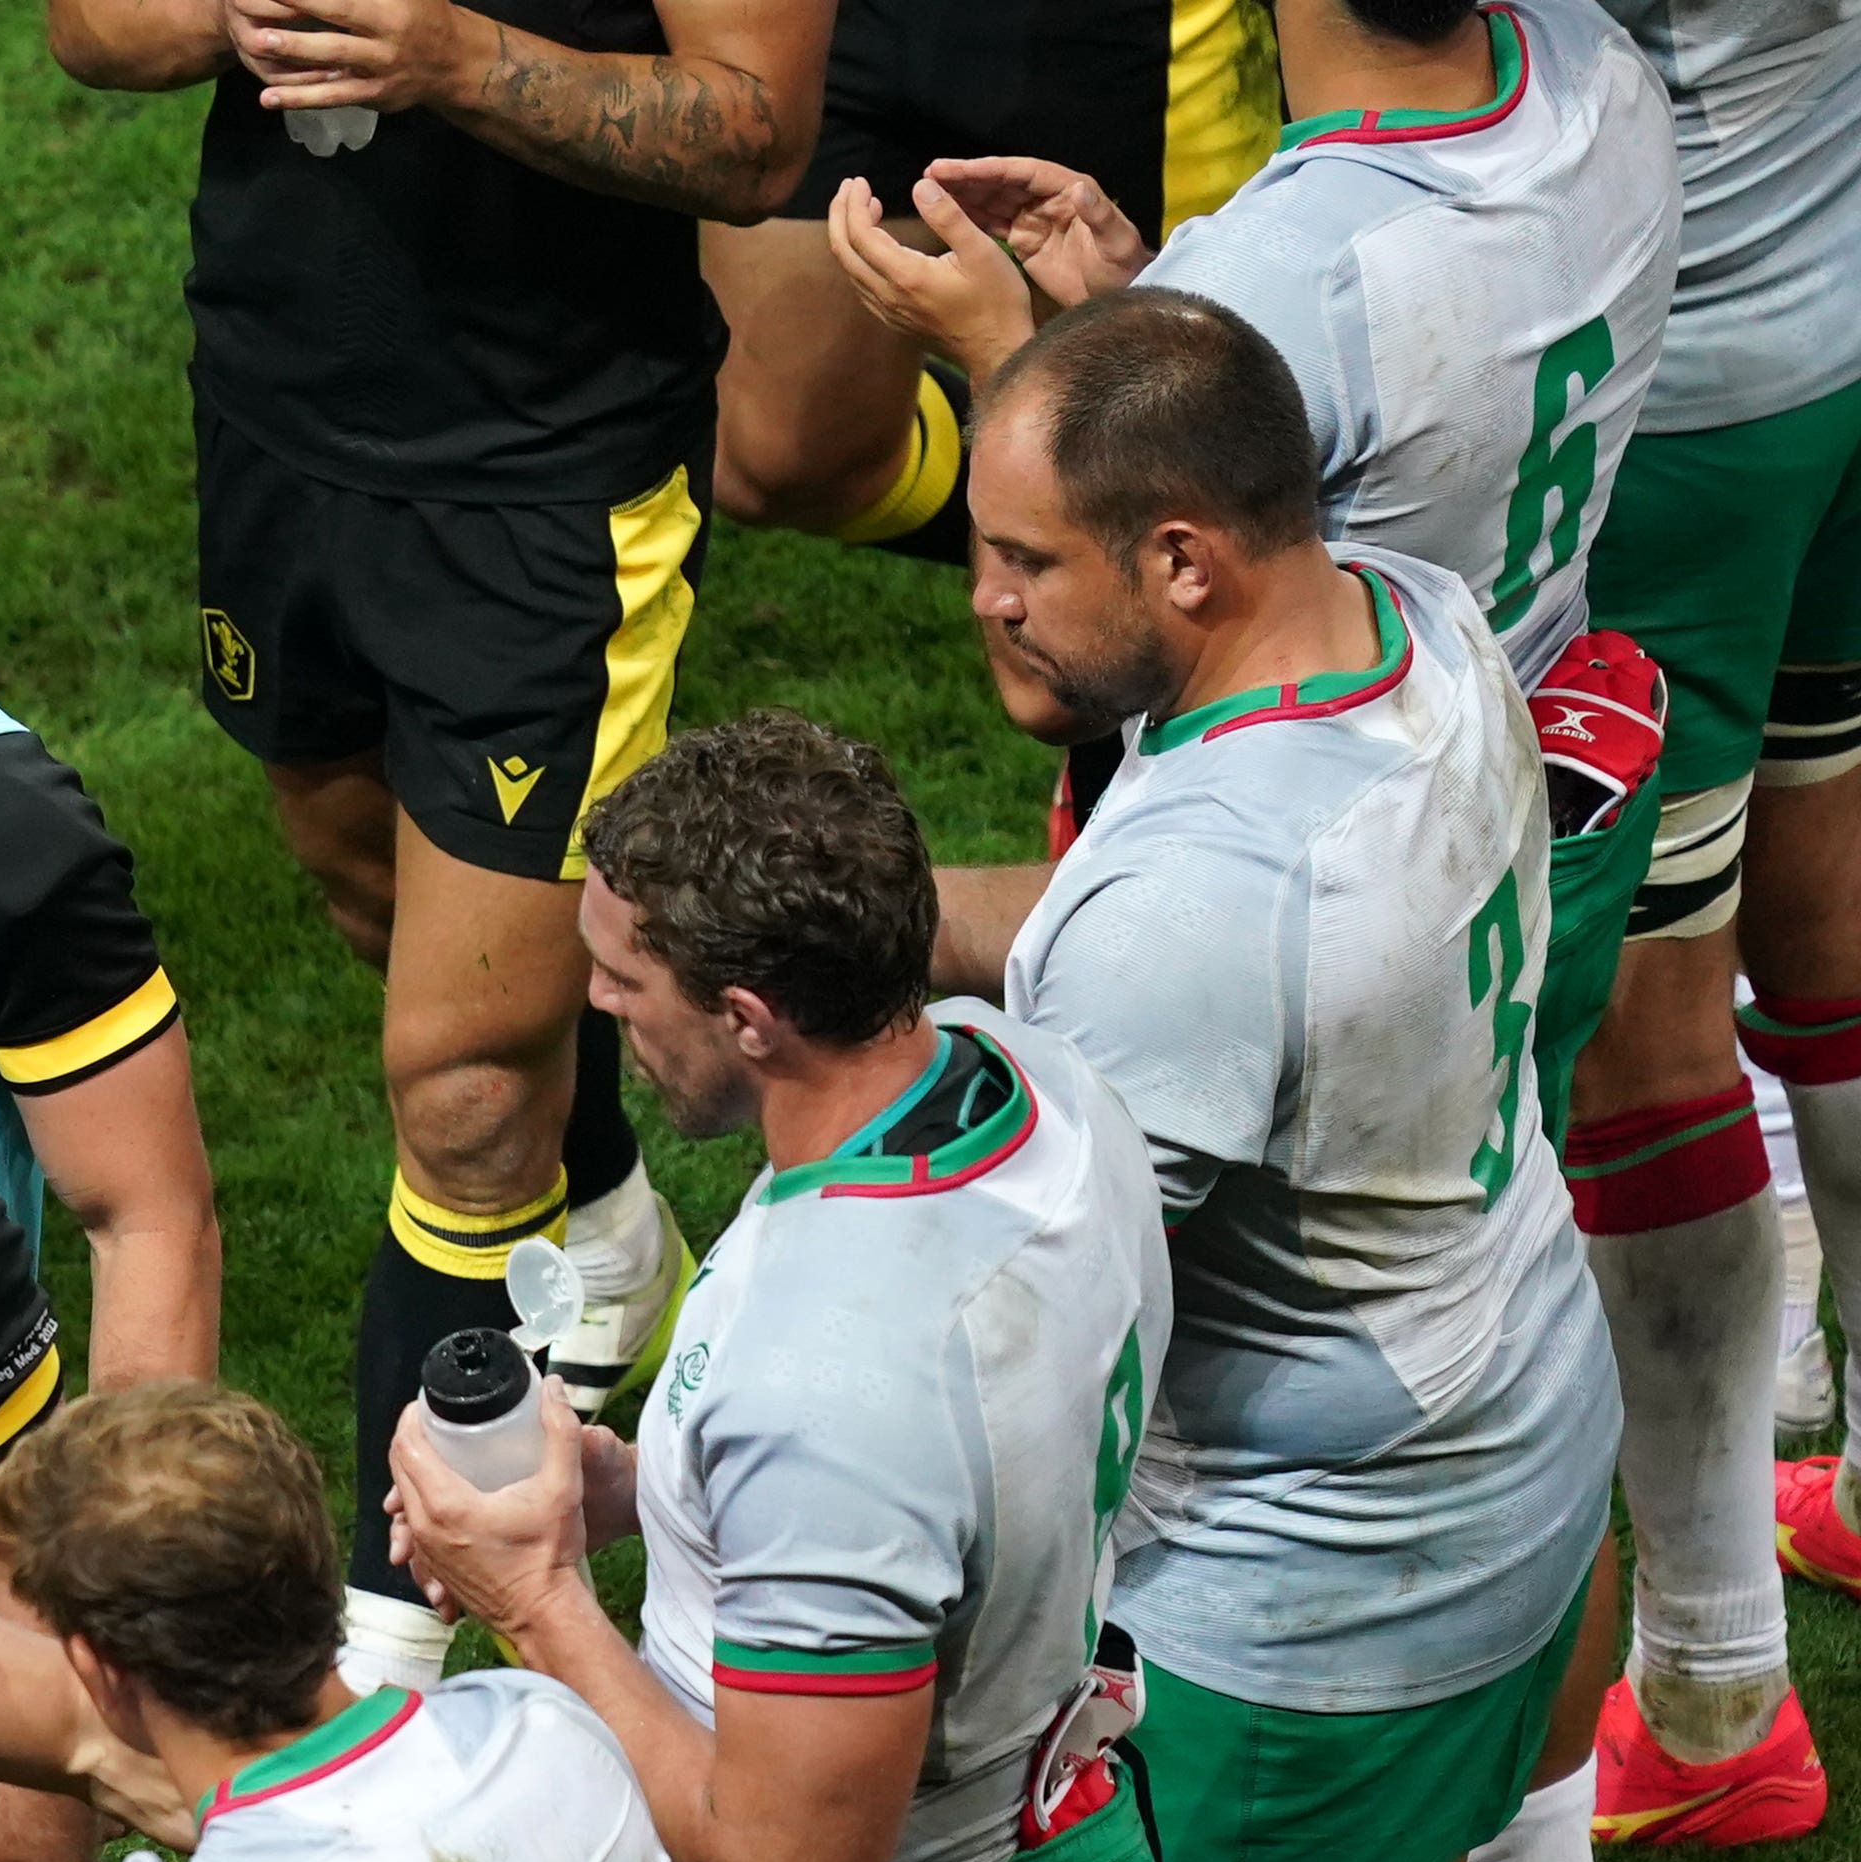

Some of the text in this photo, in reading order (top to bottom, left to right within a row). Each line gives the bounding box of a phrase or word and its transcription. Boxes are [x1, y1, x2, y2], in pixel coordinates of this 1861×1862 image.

[1486, 314, 1615, 634] 6
[1540, 727, 1594, 743] GILBERT
[1468, 865, 1532, 1213] 3
[13, 1342, 43, 1370] Medi
